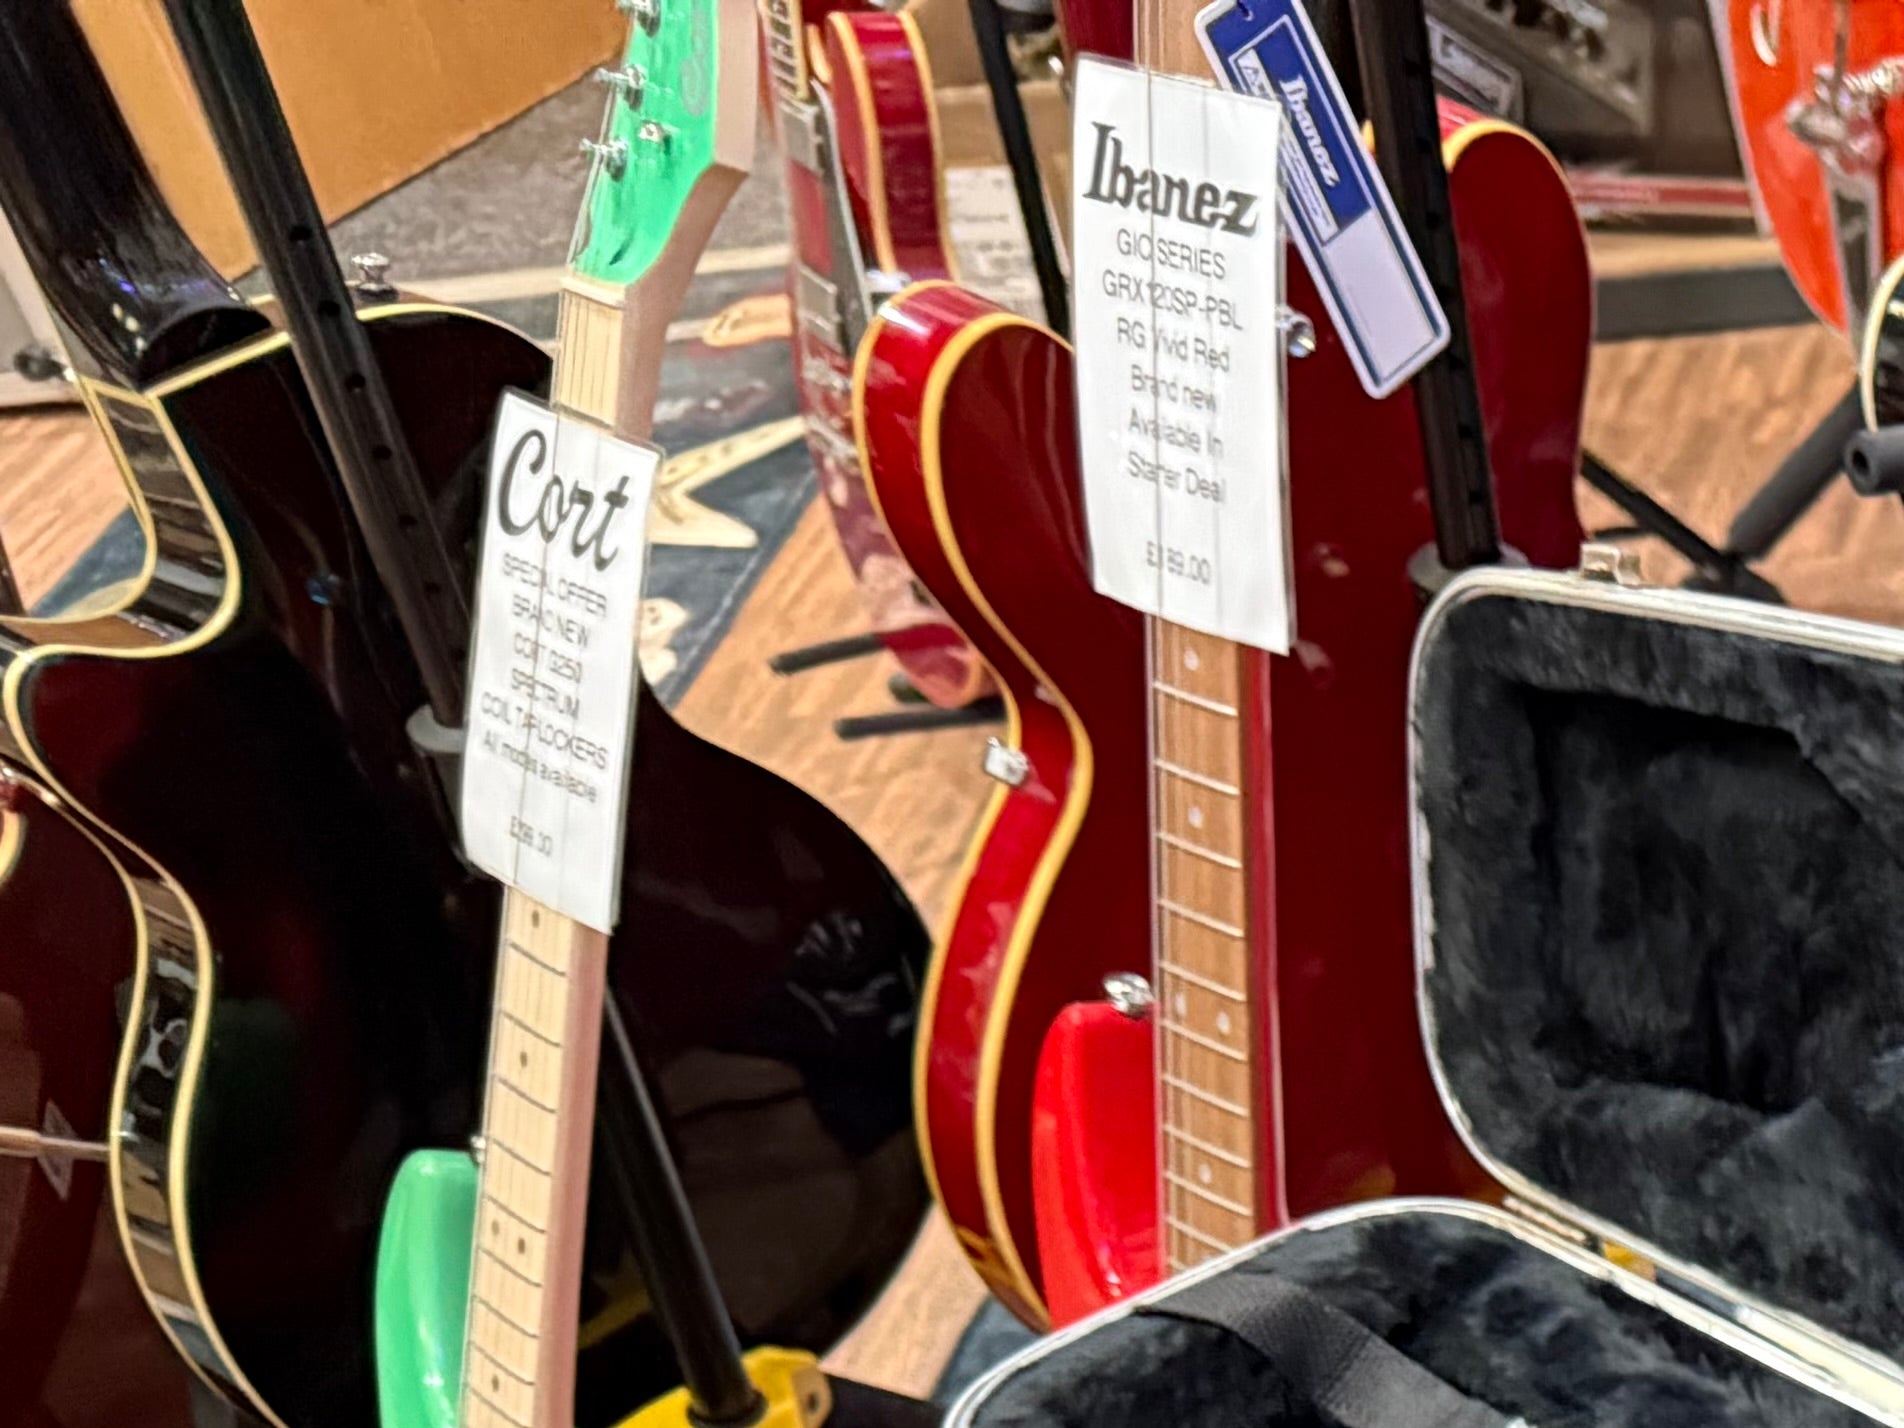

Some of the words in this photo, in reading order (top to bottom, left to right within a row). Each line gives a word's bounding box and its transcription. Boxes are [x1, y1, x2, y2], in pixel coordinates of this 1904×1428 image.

[1279, 72, 1341, 188] Ibanez
[1082, 121, 1258, 237] Ibanez
[1117, 228, 1152, 261] GIO
[1157, 238, 1226, 280] SERIES
[1102, 269, 1243, 331] GRX120SP-PBL
[1117, 317, 1146, 349] RG
[1194, 337, 1230, 373] Red
[1130, 364, 1178, 403] Brand
[1183, 386, 1217, 412] new
[1128, 408, 1201, 453] Available
[498, 429, 629, 571] Cort
[1127, 450, 1181, 490] Starter
[1185, 467, 1226, 503] Deal
[558, 577, 608, 618] OFFER
